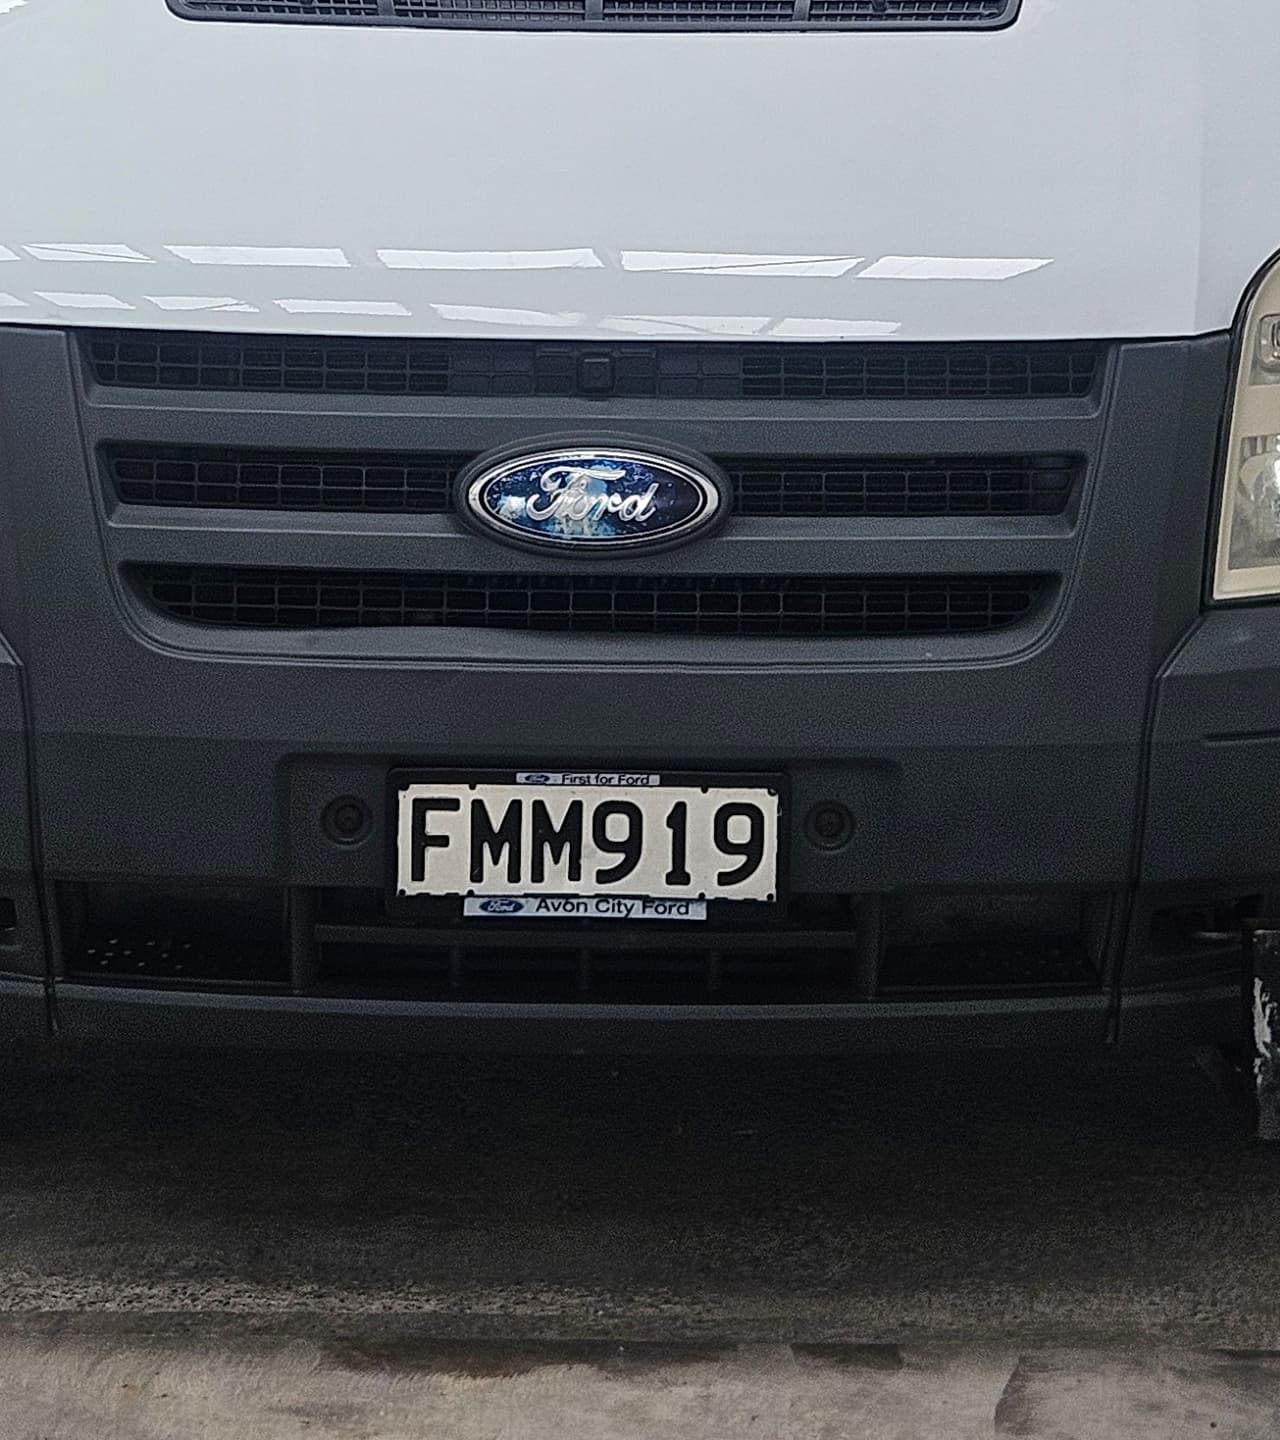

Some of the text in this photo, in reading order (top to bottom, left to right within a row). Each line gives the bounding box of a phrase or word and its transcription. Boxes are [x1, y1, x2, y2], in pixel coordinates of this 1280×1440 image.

[526, 465, 659, 522] Ford
[562, 773, 591, 785] First
[595, 773, 615, 785] for
[618, 774, 650, 786] Ford
[411, 797, 765, 886] FMM919
[535, 897, 690, 918] Avon City Ford
